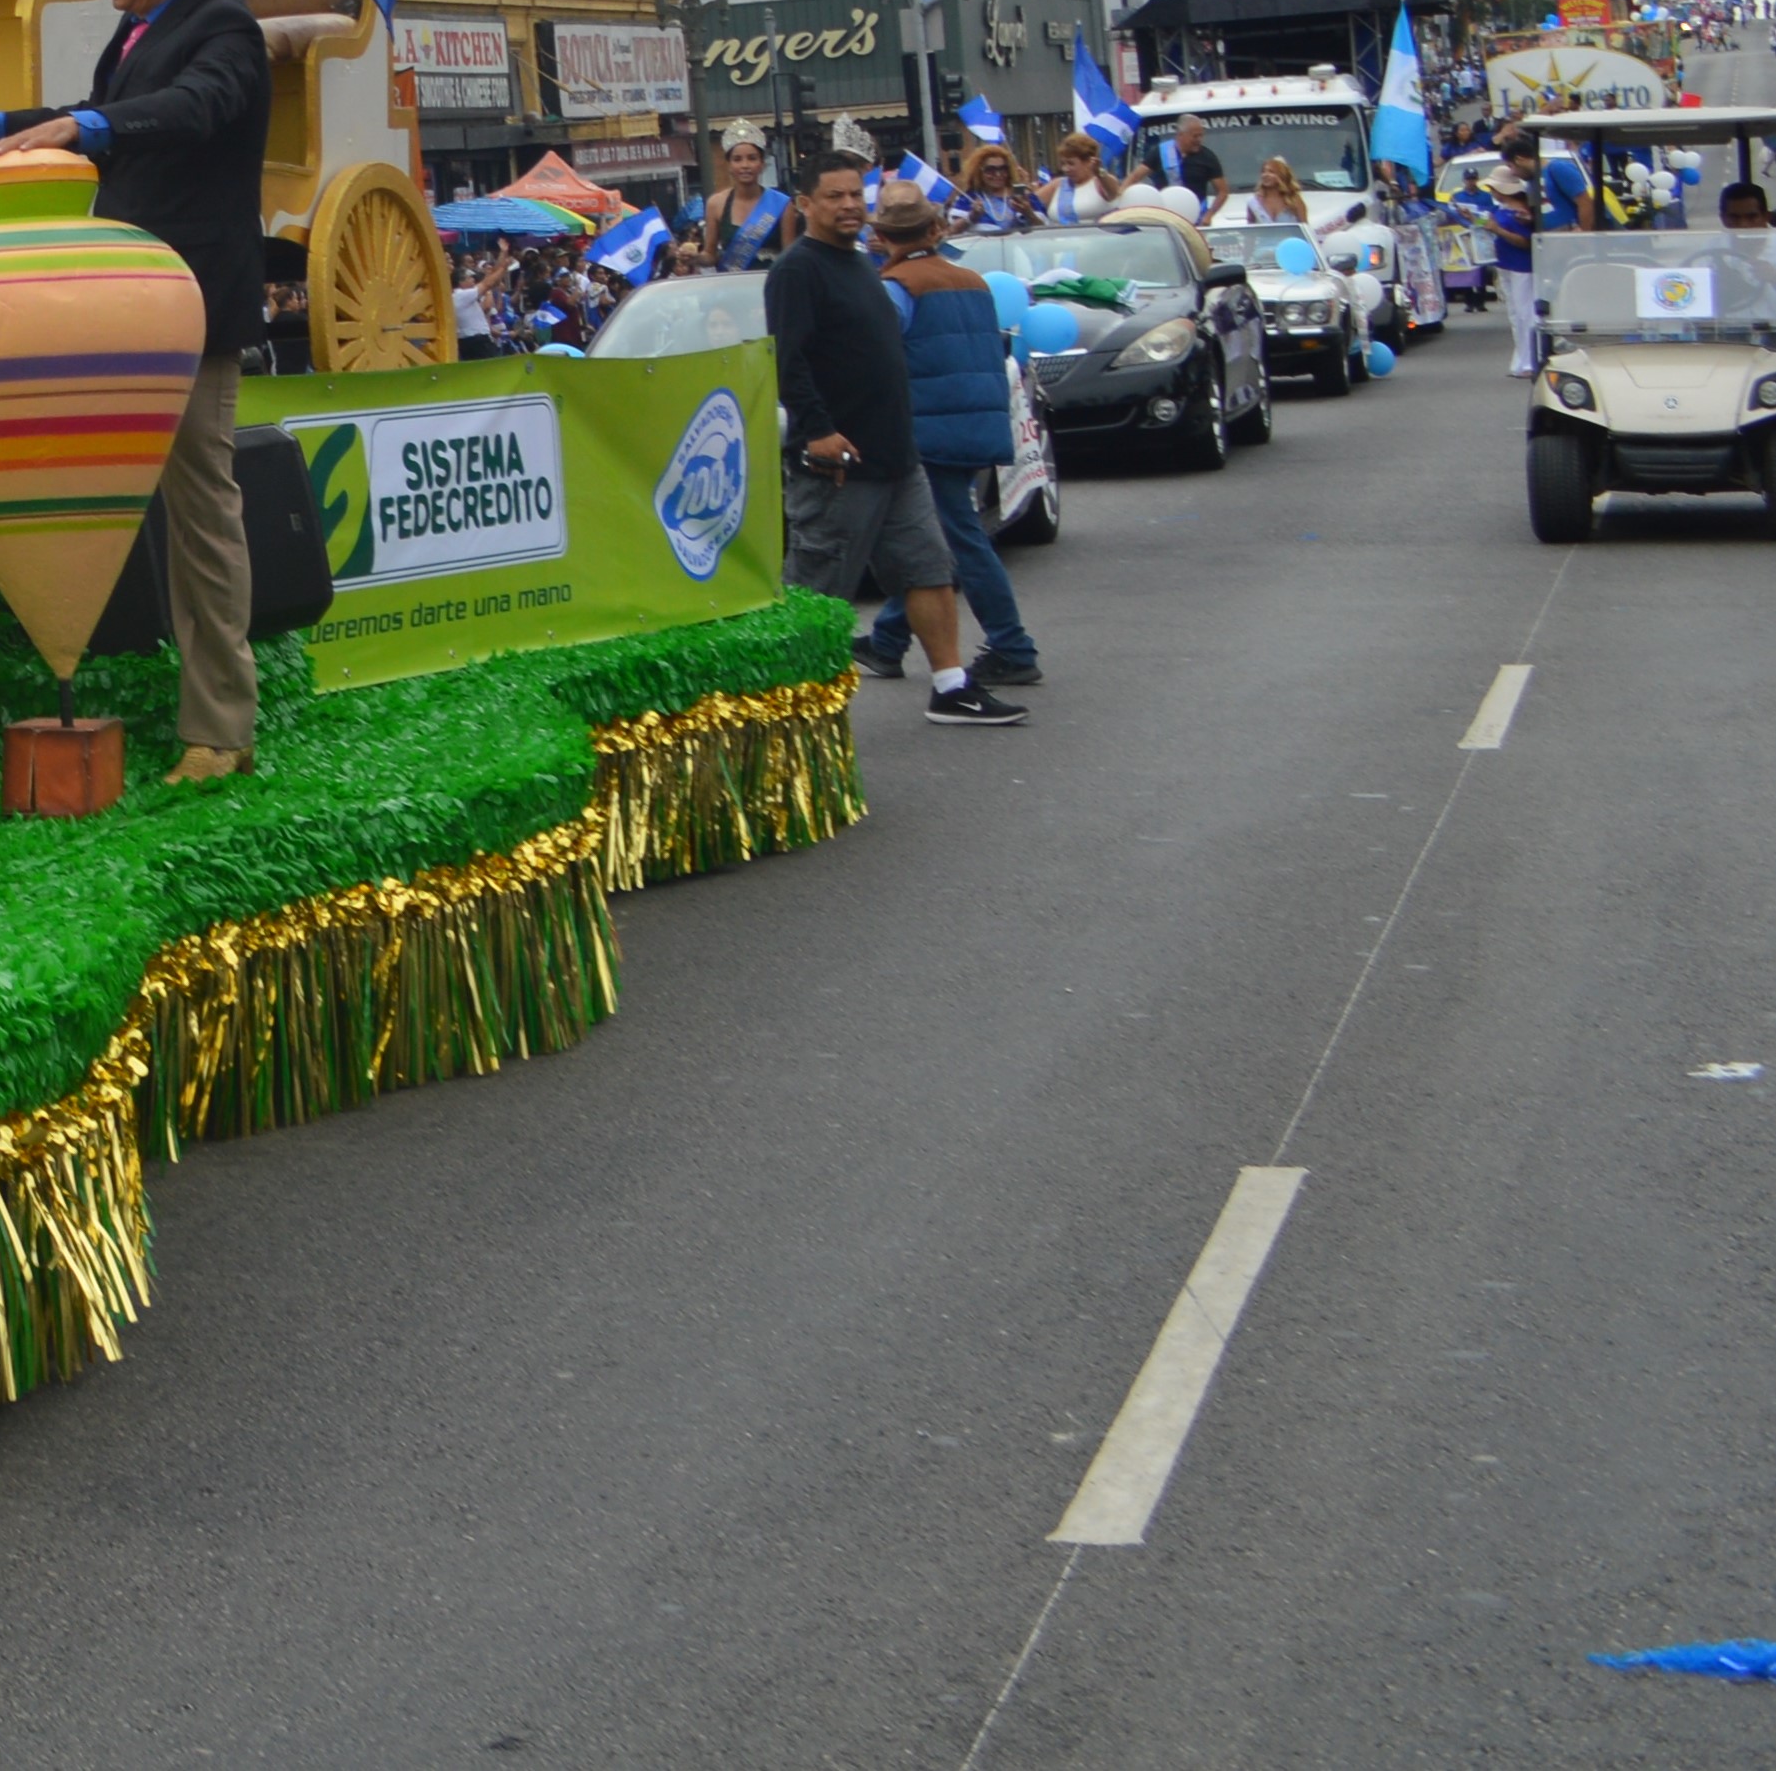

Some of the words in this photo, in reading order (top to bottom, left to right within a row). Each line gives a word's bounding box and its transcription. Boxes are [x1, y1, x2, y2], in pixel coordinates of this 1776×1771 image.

[433, 30, 504, 67] KITCHEN
[557, 34, 615, 84] BOTICA
[633, 35, 684, 83] PUEBLO
[1259, 112, 1340, 127] TOWING
[402, 431, 525, 491] SISTEMA
[379, 476, 552, 543] FEDECREDITO
[309, 611, 403, 645] ueremos
[410, 600, 467, 628] darte
[474, 592, 511, 617] una
[518, 583, 572, 610] mano
